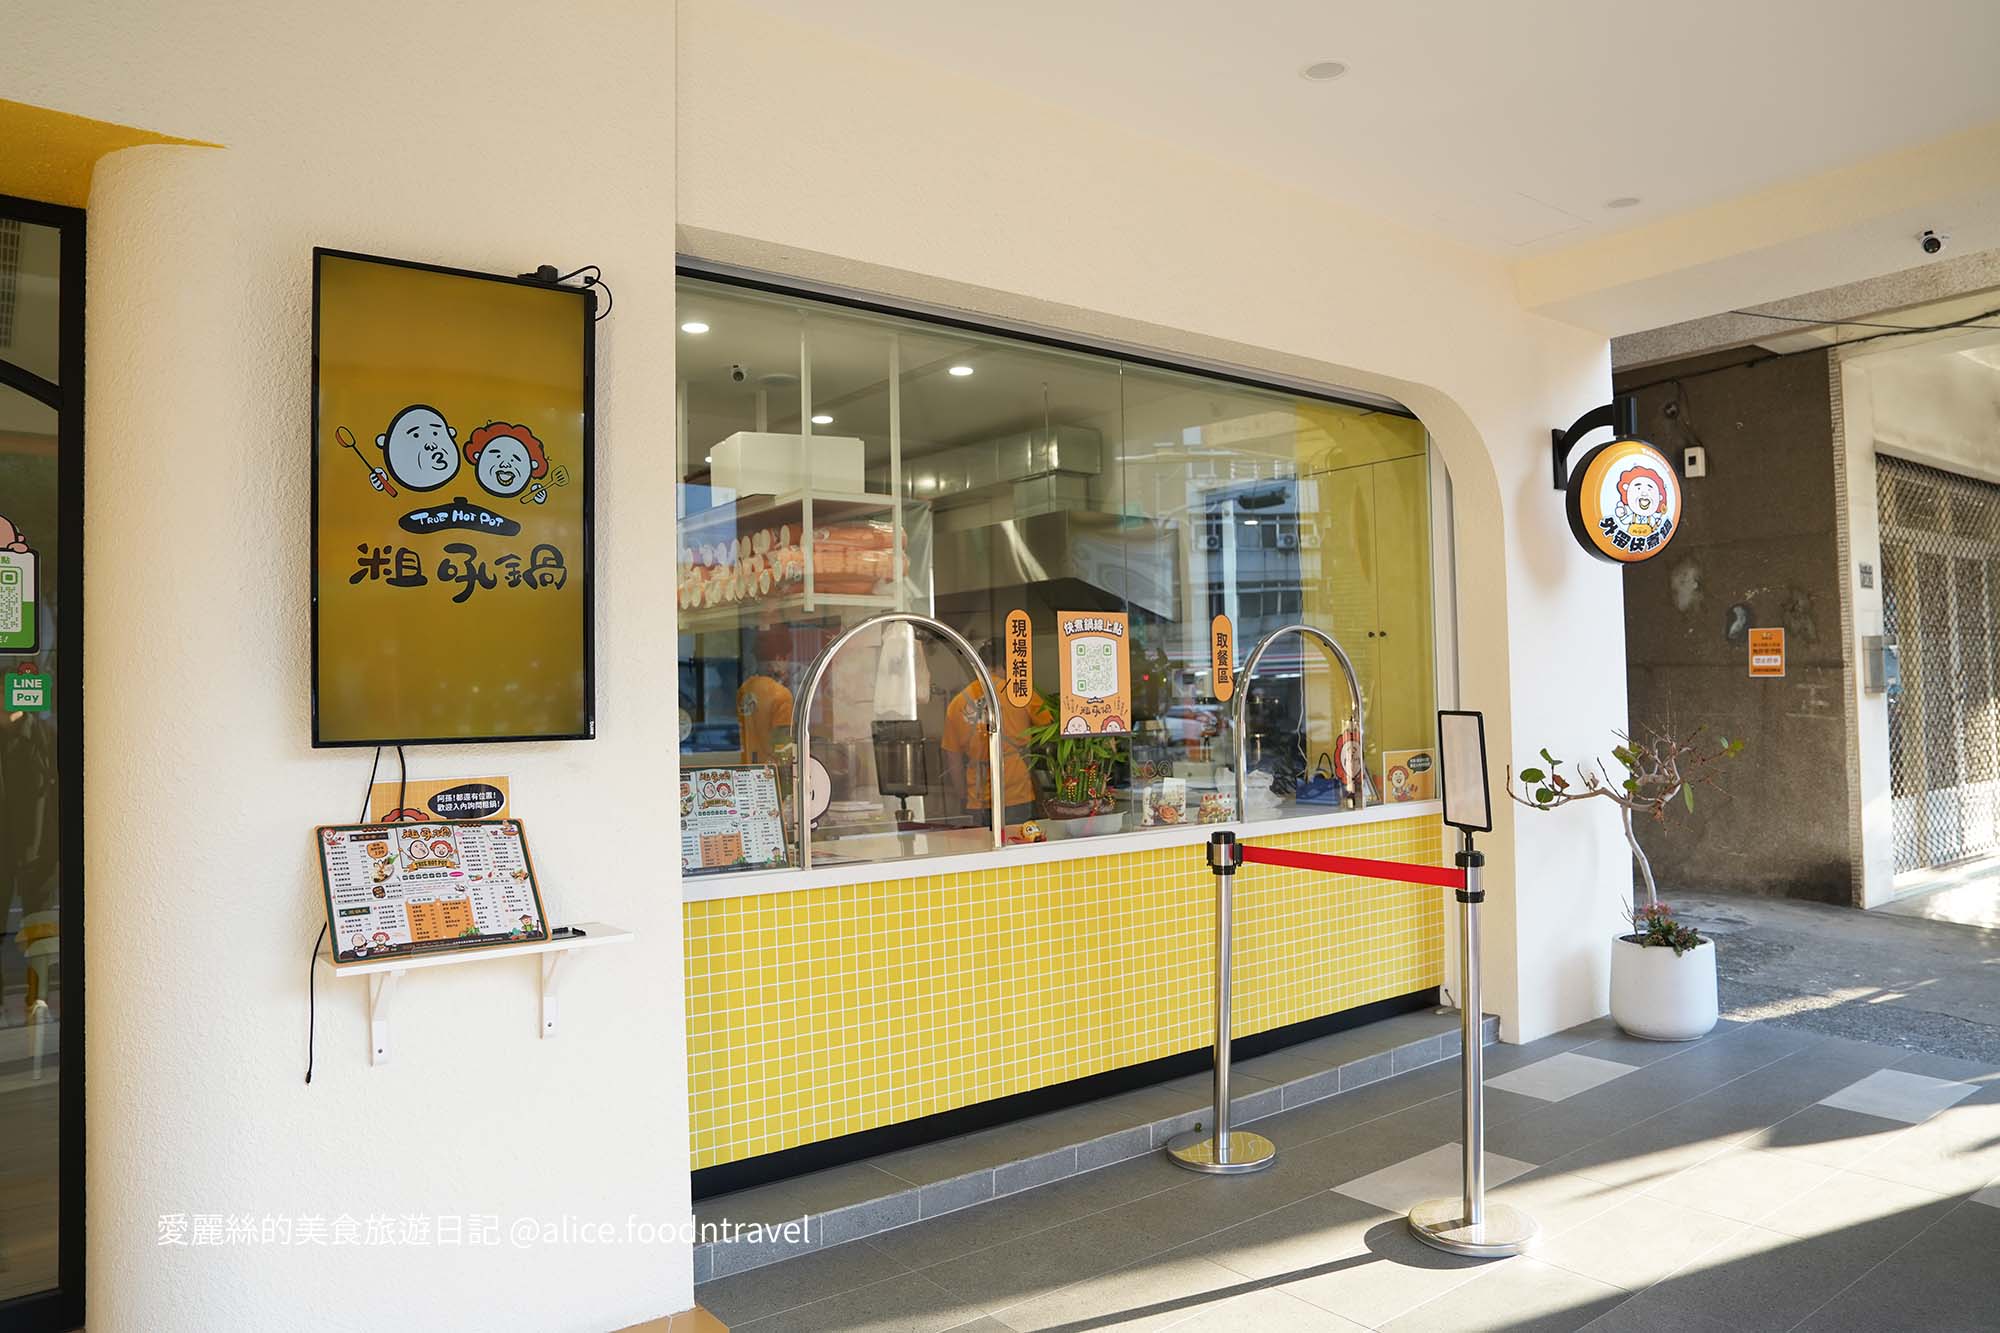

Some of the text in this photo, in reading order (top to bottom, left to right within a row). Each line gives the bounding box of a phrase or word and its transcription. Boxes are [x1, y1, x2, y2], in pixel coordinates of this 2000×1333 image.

[348, 543, 569, 604] 粗吼鍋
[1063, 618, 1124, 638] 快煮鍋線上點
[1011, 619, 1028, 698] 現場結帳
[1216, 632, 1230, 684] 取餐區
[13, 679, 42, 689] LINE
[16, 692, 39, 704] Pay
